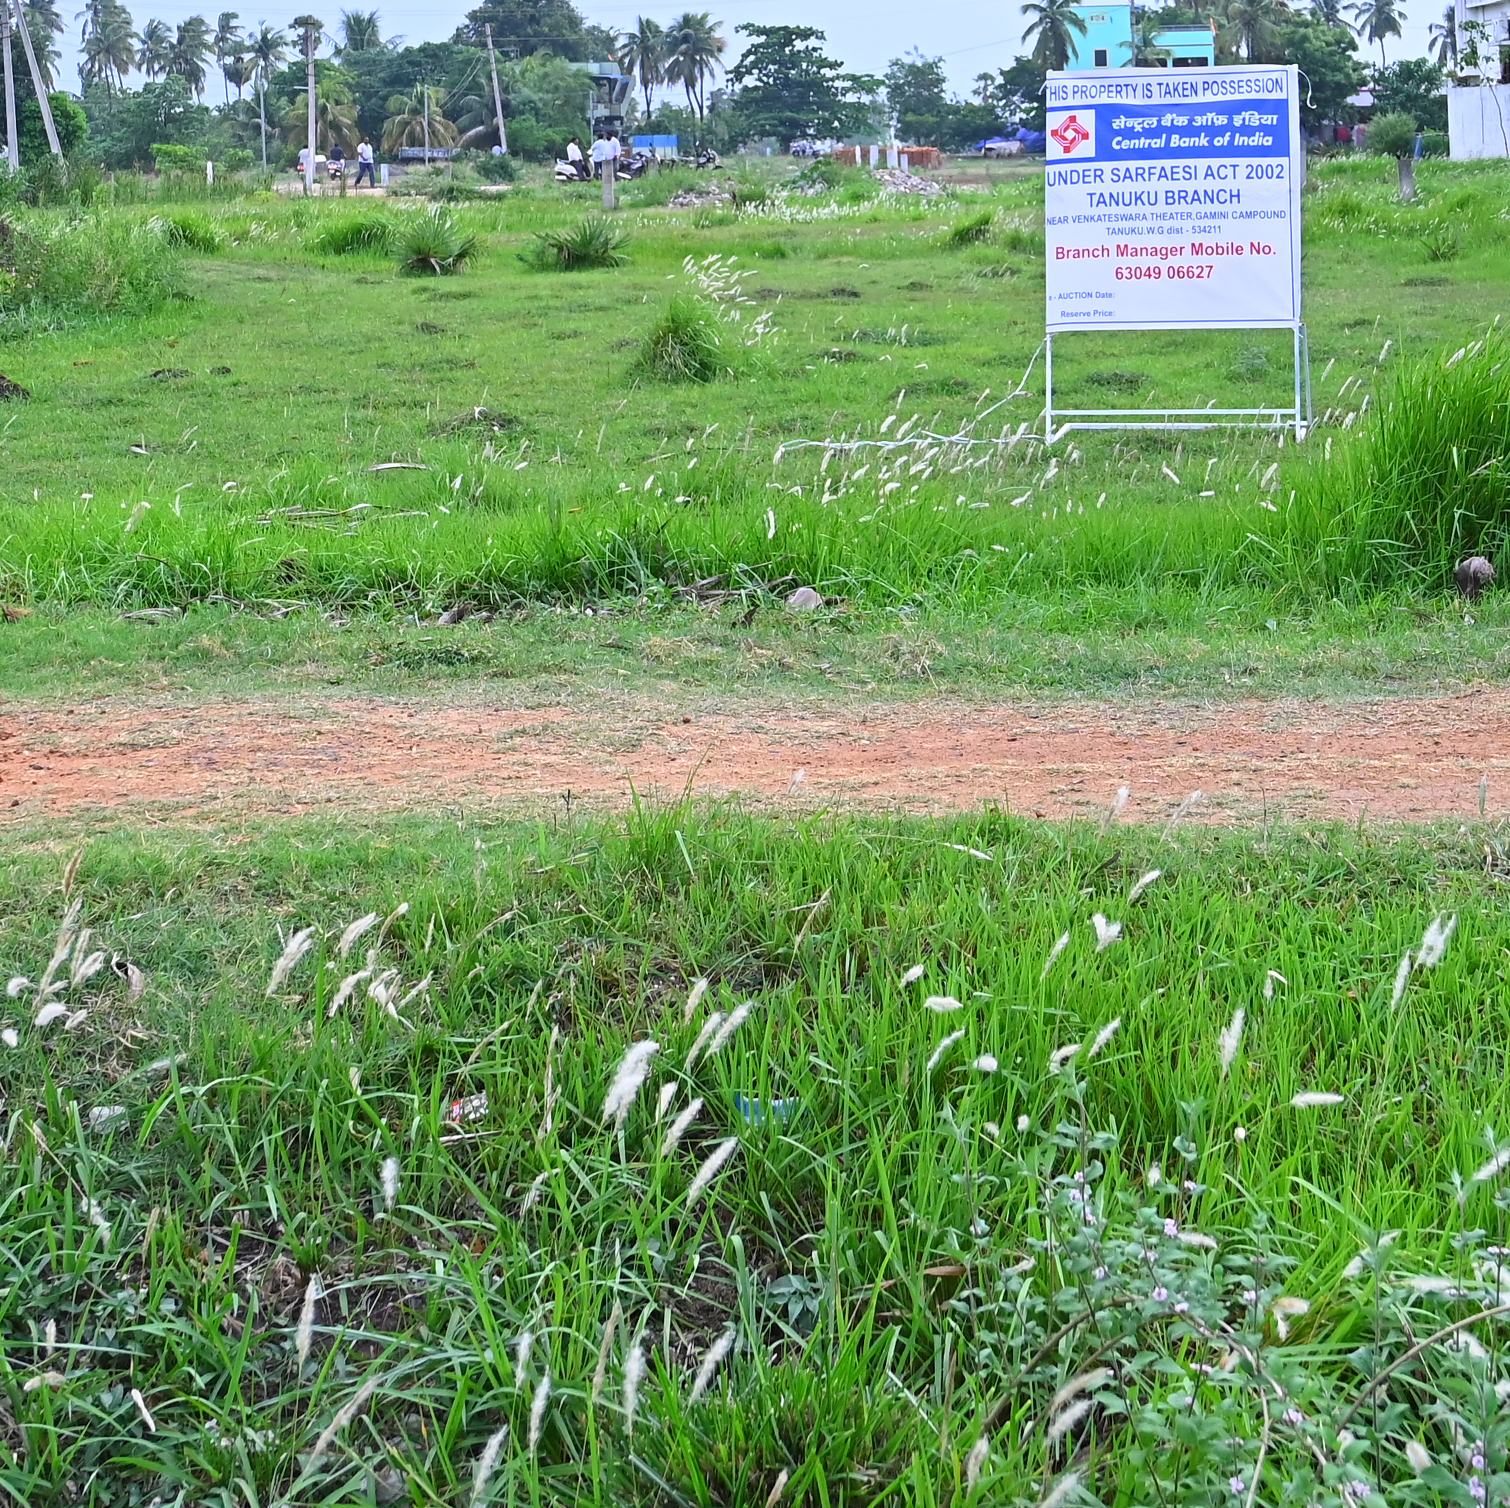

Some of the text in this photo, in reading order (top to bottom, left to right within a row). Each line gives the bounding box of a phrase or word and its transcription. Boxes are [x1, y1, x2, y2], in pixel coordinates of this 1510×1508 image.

[1047, 77, 1283, 101] HIS PROPERTY IS TAKEN POSSESSION
[1161, 113, 1190, 127] बैंक
[1232, 111, 1278, 127] इंडिया
[1112, 132, 1273, 150] Central Bank of India
[1047, 164, 1284, 187] UNDER SARFAESI ACT 2002
[1086, 188, 1240, 208] TANUKU BRANCH
[1047, 216, 1069, 226] NEAR
[1072, 213, 1147, 224] VENKATESWARA
[1232, 210, 1286, 220] CAMPOUND
[1167, 226, 1183, 235] dist
[1191, 225, 1221, 234] 534211
[1056, 242, 1276, 260] Branch Manager Mobile No.
[1115, 265, 1214, 280] 63049 06627
[1058, 292, 1092, 300] AUCTION
